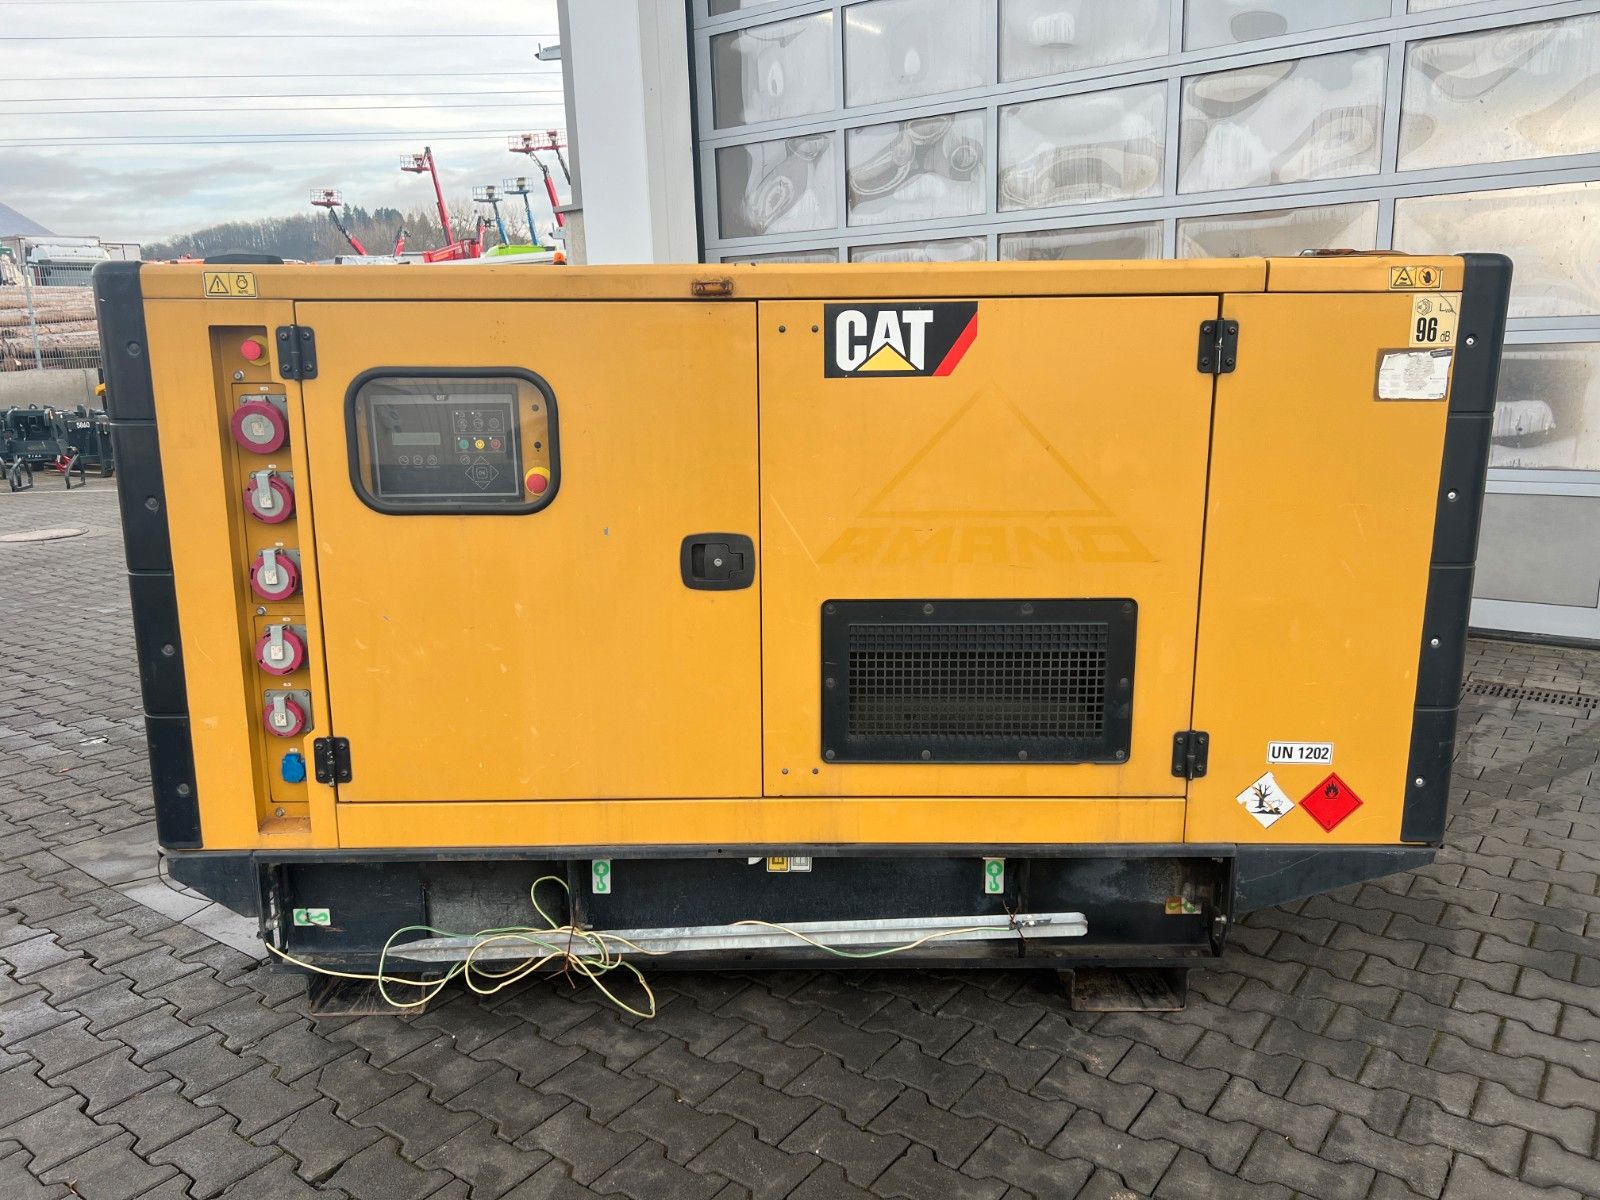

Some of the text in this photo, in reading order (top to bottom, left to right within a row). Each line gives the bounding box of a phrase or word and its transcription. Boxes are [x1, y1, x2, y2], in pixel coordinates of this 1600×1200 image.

[836, 309, 934, 372] CAT
[1416, 317, 1451, 342] 96 dB
[1271, 746, 1329, 760] UN 1202
